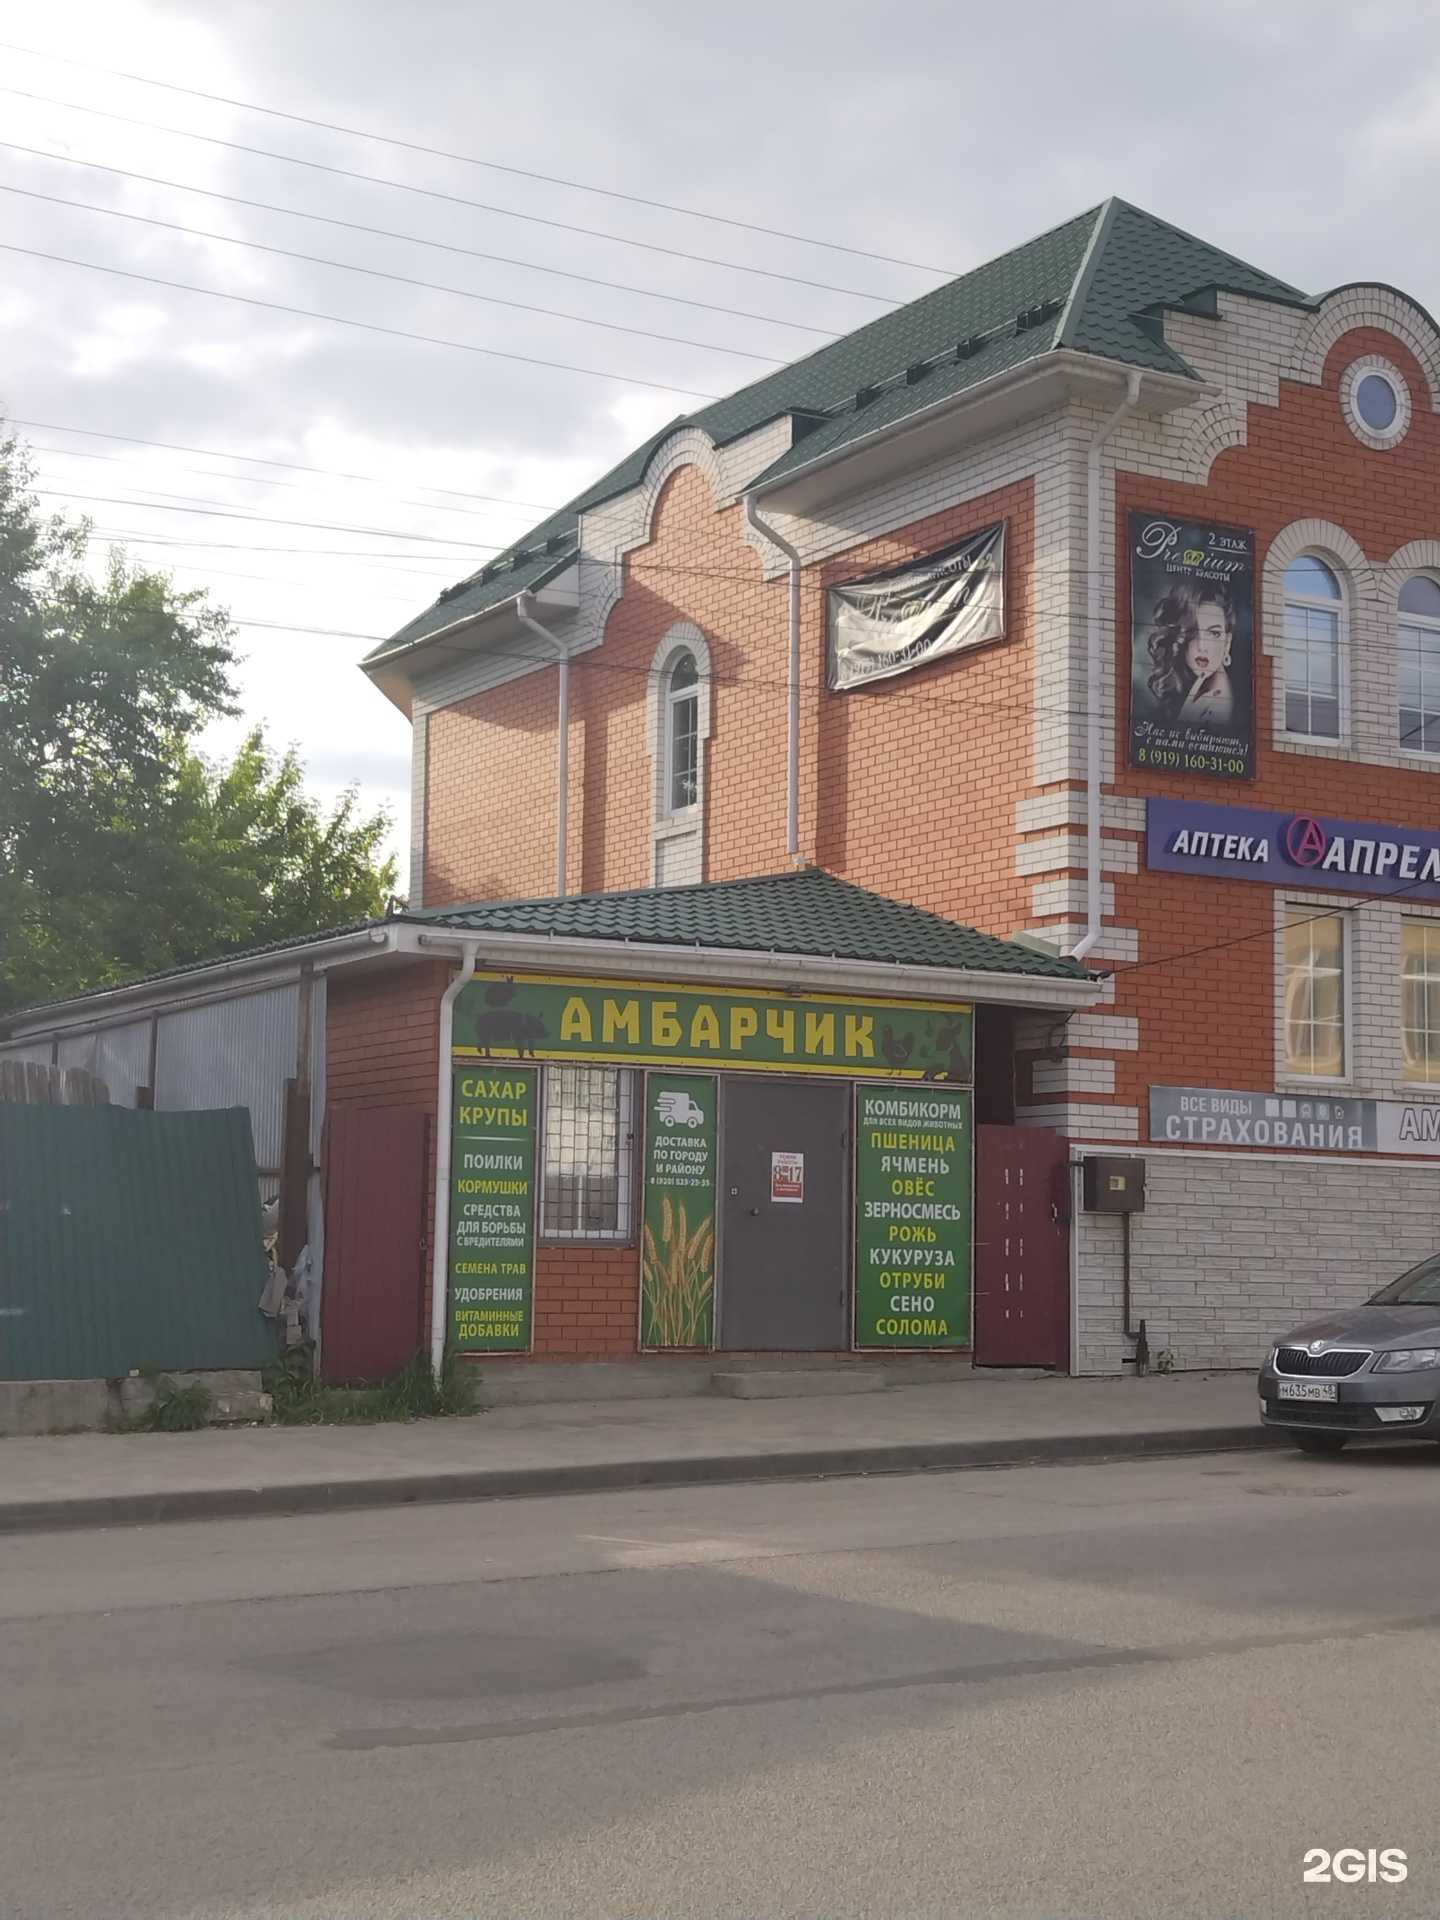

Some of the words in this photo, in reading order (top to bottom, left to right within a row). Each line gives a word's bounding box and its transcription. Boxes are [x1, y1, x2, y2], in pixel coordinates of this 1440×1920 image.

[1208, 532, 1216, 546] 2
[1219, 537, 1247, 550] ЭТАЖ
[1139, 748, 1147, 762] 8
[1150, 750, 1180, 767] (919)
[1184, 754, 1244, 773] 160-31-00
[1172, 829, 1270, 863] АПТЕКА
[1321, 836, 1440, 882] АПРЕЛ
[560, 997, 876, 1058] АМБАРЧИК
[462, 1079, 527, 1100] САХАР
[865, 1099, 961, 1120] КОМБИКОРМ
[1180, 1095, 1208, 1113] ВСЕ
[1210, 1098, 1253, 1116] ВИДЫ
[459, 1106, 528, 1127] КРУПЫ
[1166, 1114, 1363, 1149] СТРАХОВАНИЯ
[655, 1136, 707, 1148] ДОСТАВКА
[871, 1132, 956, 1154] ПШЕНИЦА
[464, 1154, 523, 1171] ПОИЛКИ
[653, 1149, 668, 1160] ПО
[670, 1150, 708, 1163] ГОРОДУ
[656, 1163, 663, 1173] И
[665, 1163, 705, 1175] РАЙОНУ
[881, 1156, 950, 1175] ЯЧМЕНЬ
[458, 1179, 528, 1195] КОРМУШКИ
[892, 1177, 935, 1197] ОВЁС
[463, 1204, 521, 1218] СРЕДСТВА
[864, 1201, 961, 1220] ЗЕРНОСМЕСЬ
[457, 1221, 480, 1235] ДЛЯ
[481, 1222, 526, 1234] БОРЬБЫ
[889, 1225, 937, 1243] РОЖЬ
[457, 1236, 463, 1246] С
[464, 1237, 524, 1247] ВРЕДИТЕЛЯМИ
[869, 1247, 955, 1267] КУКУРУЗА
[455, 1263, 498, 1274] СЕМЕНА
[501, 1263, 527, 1274] ТРАВ
[880, 1271, 945, 1289] ОТРУБИ
[455, 1287, 523, 1302] УДОБРЕНИЯ
[890, 1295, 935, 1313] СЕНО
[455, 1310, 524, 1322] ВИТАМИННЫЕ
[459, 1323, 519, 1339] ДОБАВКИ
[876, 1318, 949, 1336] СОЛОМА
